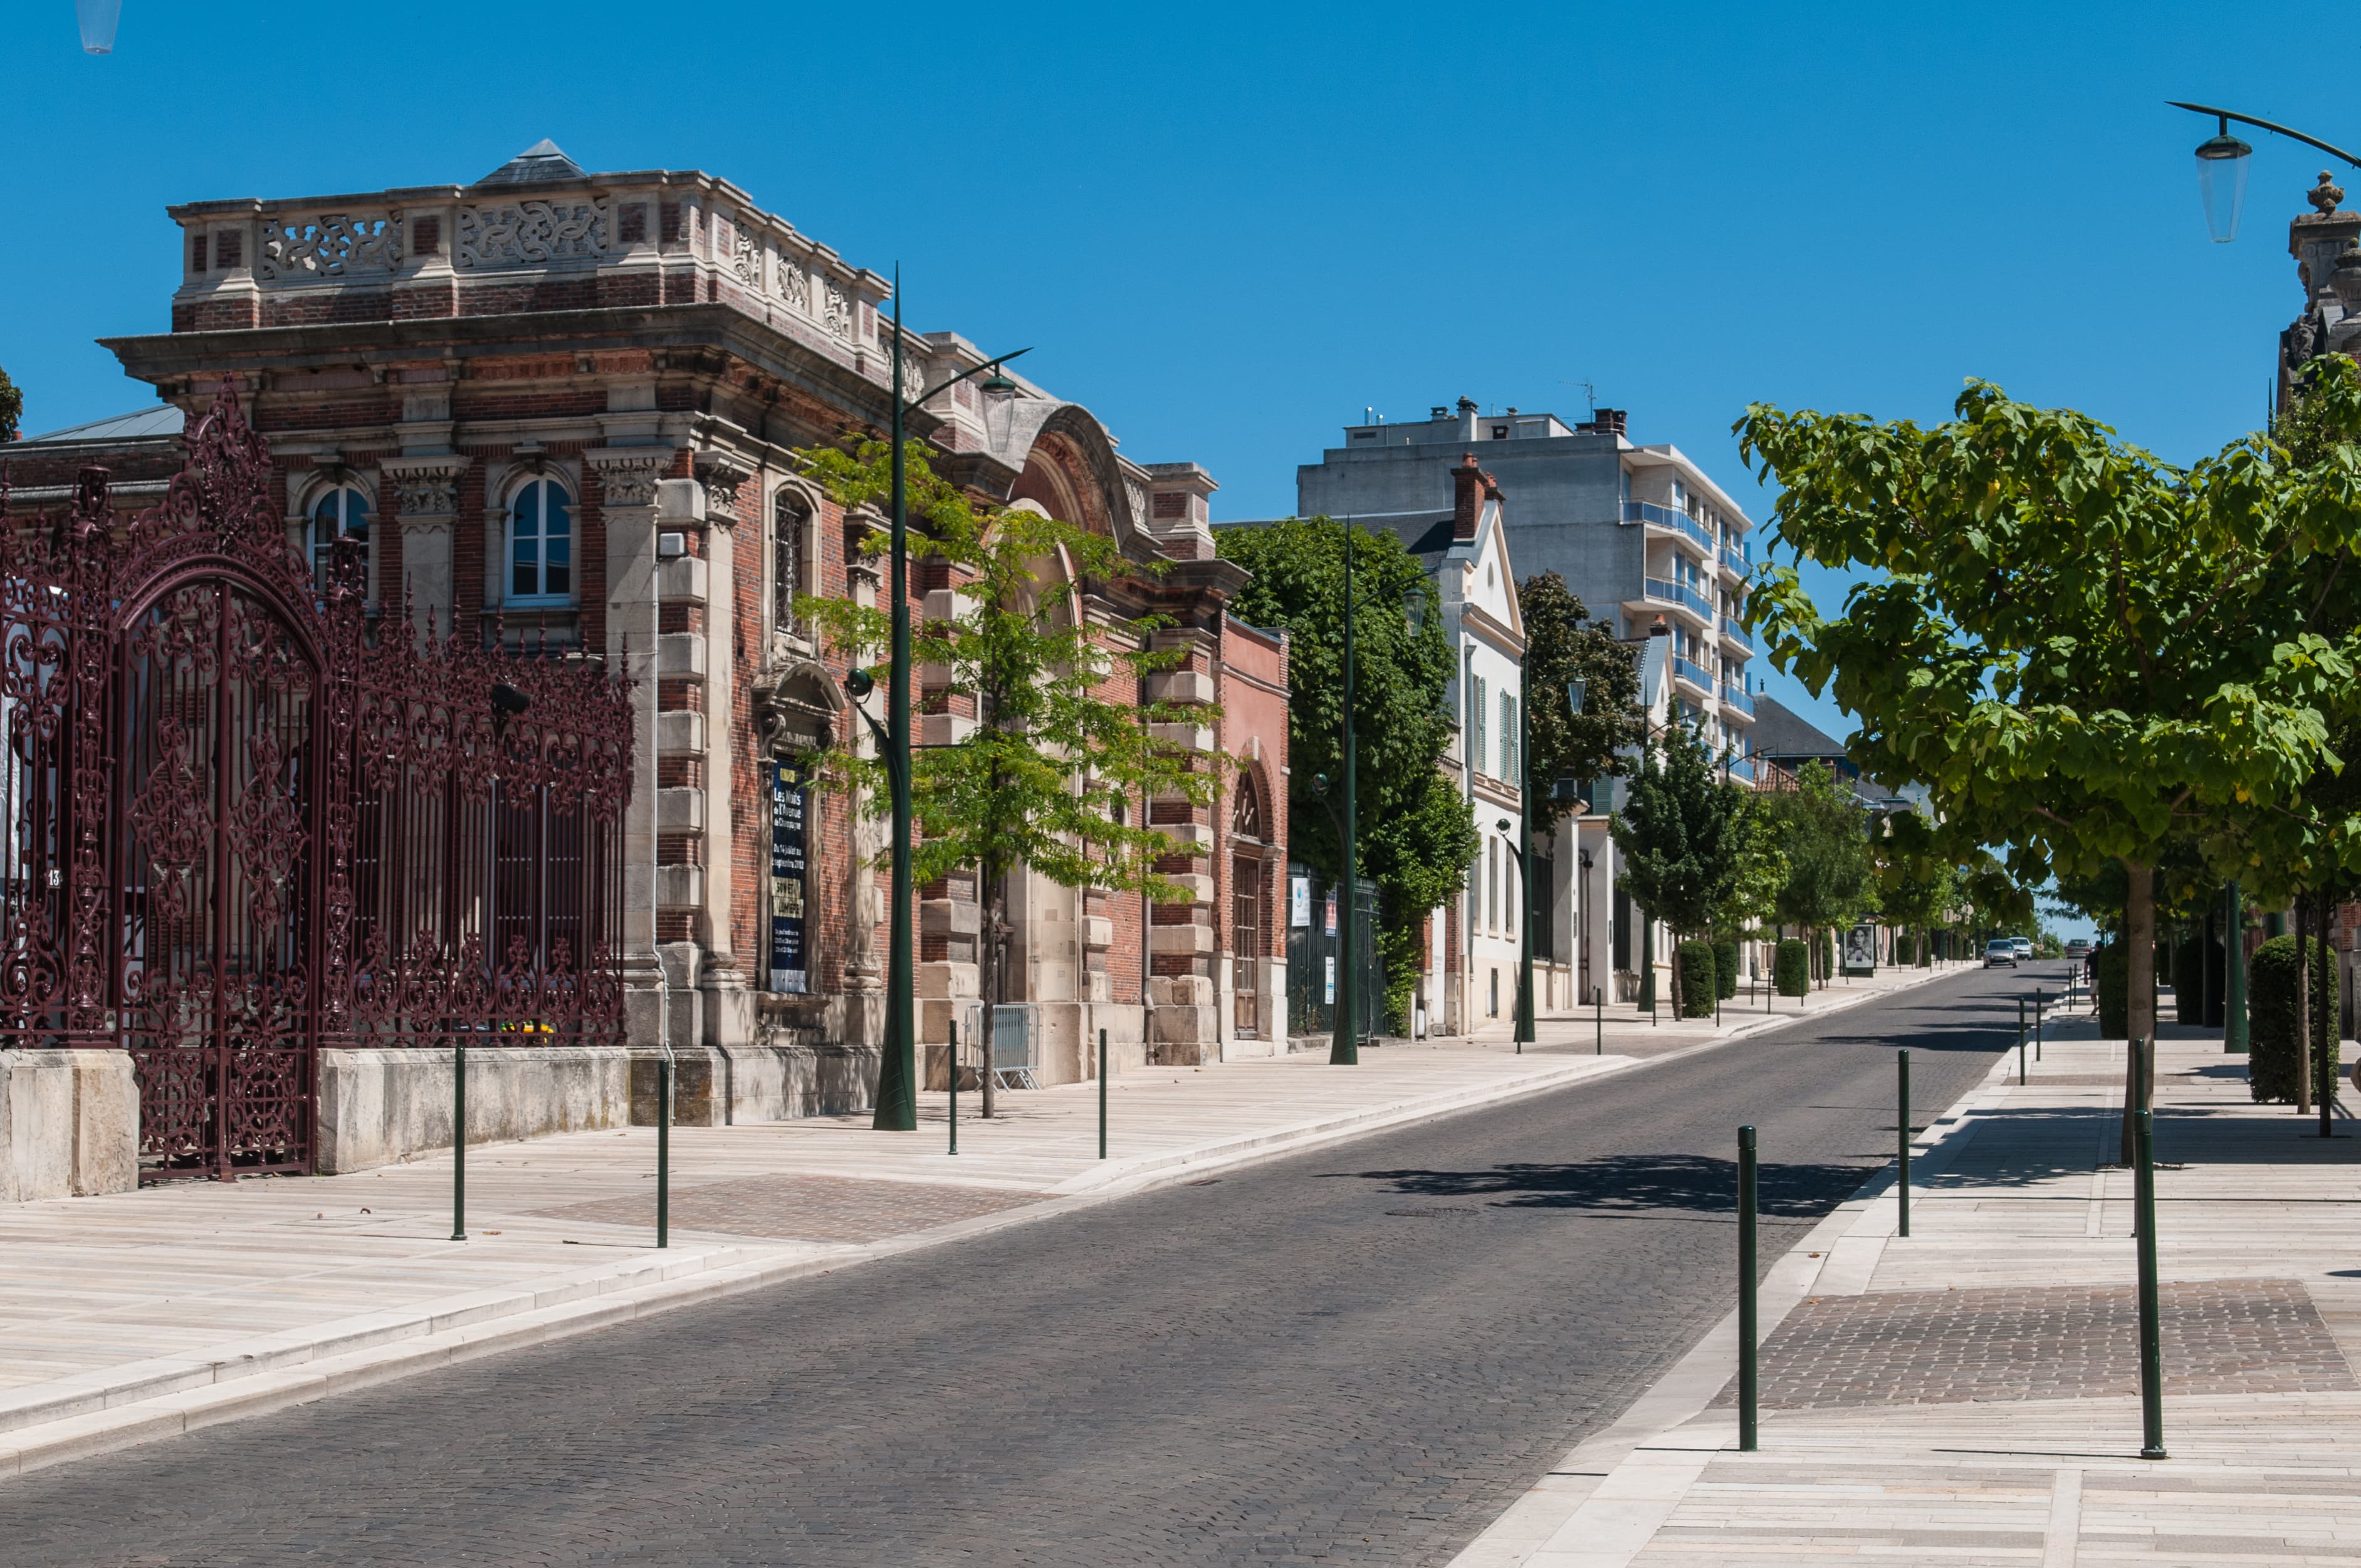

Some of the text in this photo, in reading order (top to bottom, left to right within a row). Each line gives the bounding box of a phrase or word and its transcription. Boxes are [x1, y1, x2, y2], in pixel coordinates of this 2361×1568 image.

[774, 787, 801, 806] Les Nuits
[48, 869, 60, 886] 13
[777, 882, 793, 894] SON ET
